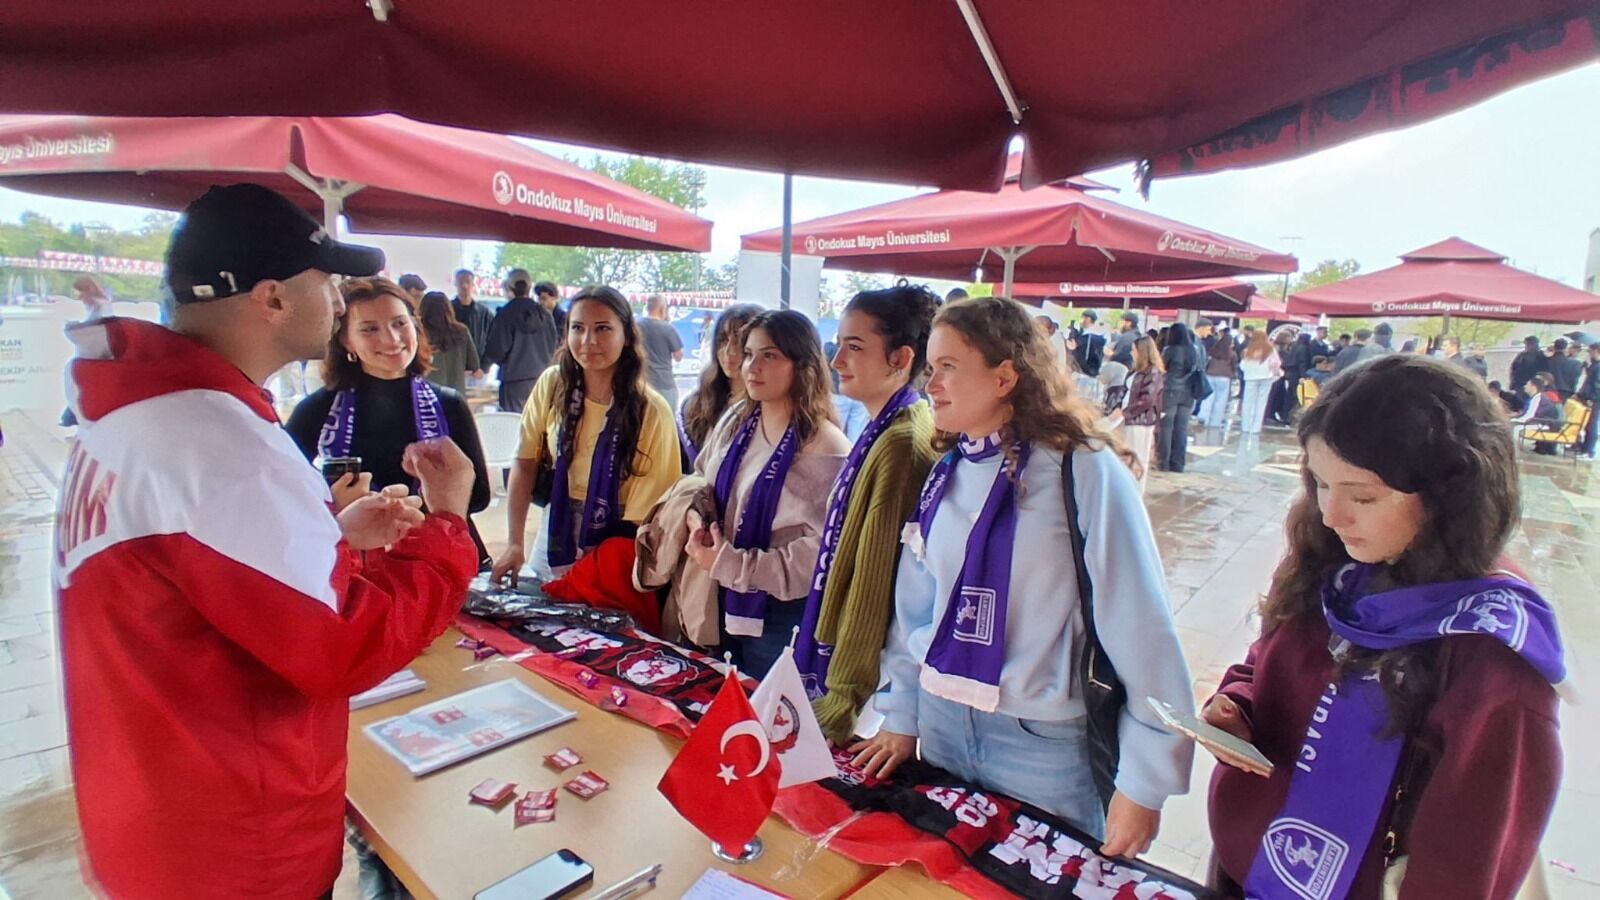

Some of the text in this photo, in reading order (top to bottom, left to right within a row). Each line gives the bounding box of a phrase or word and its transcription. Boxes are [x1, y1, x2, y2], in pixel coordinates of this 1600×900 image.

[516, 184, 657, 233] Ondokuz Mayıs Üniversitesi
[818, 229, 950, 250] Ondokuz Mayıs Üniversitesi
[1387, 300, 1521, 313] Ondokuz Mayıs Üniversitesi
